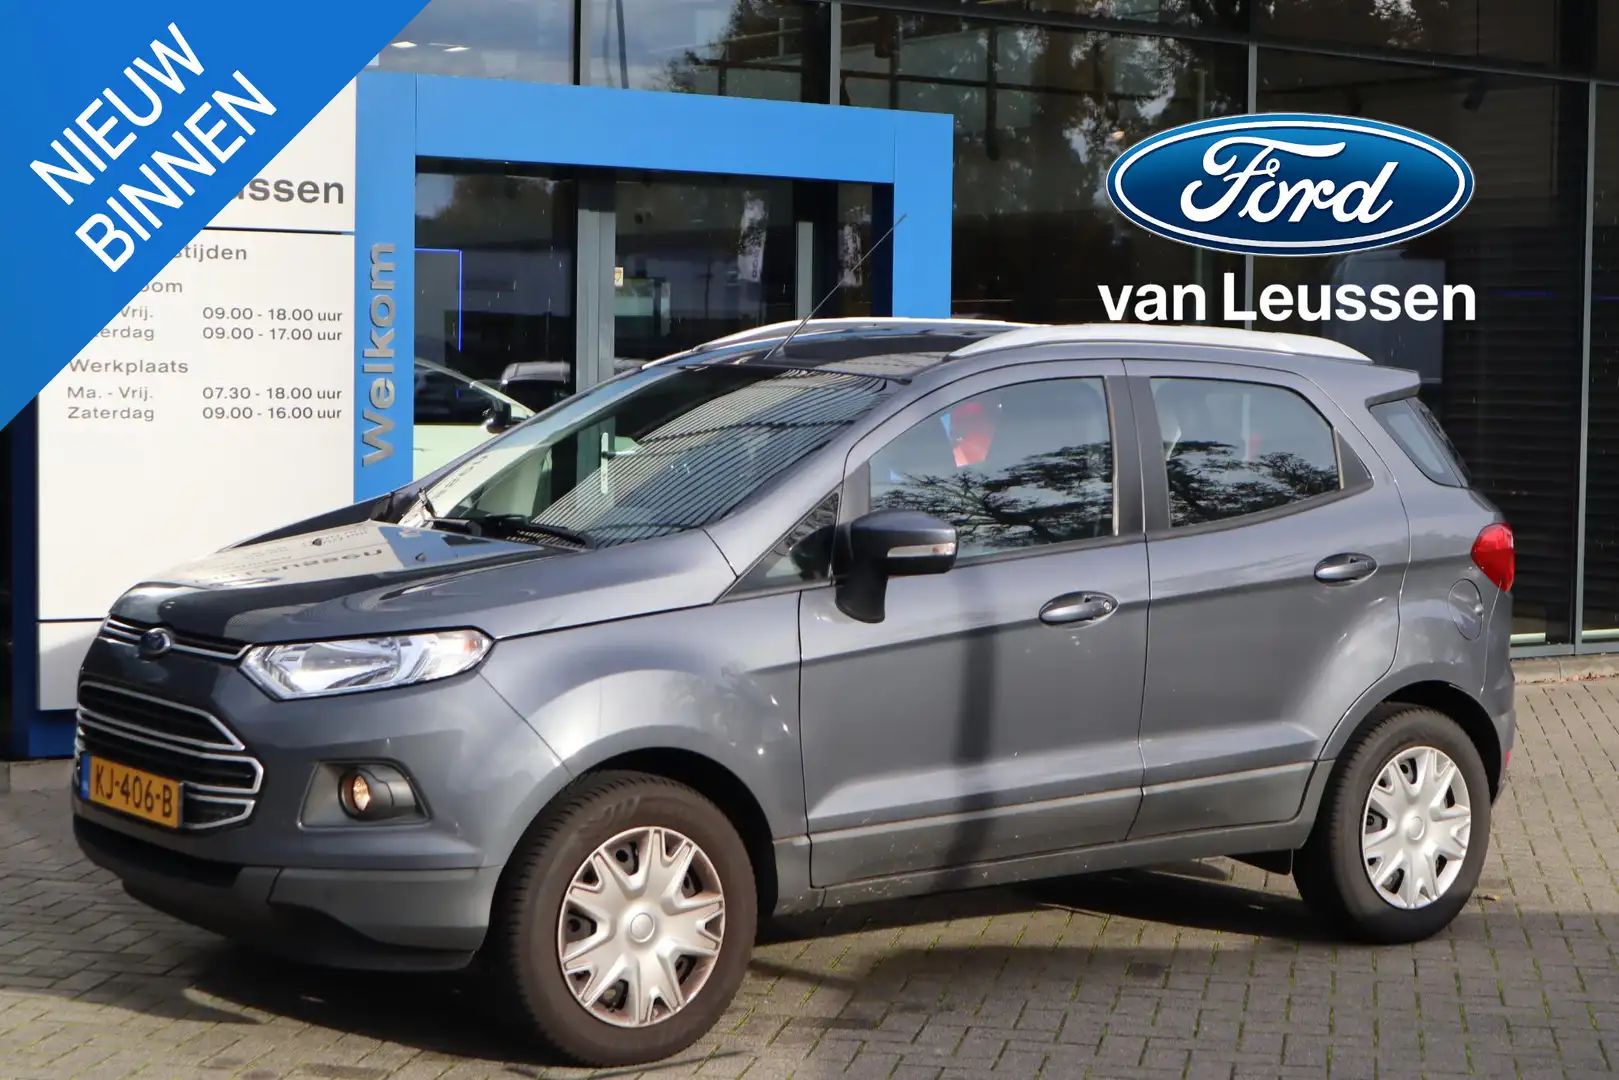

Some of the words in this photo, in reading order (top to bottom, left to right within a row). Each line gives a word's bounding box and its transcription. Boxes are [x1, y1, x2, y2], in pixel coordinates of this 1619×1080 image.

[234, 178, 344, 204] ssen
[202, 307, 253, 320] 09.00
[268, 308, 314, 321] 18.00
[317, 311, 343, 321] uur
[96, 326, 155, 342] erdag
[202, 327, 254, 340] 09.00
[269, 328, 313, 341] 17.00
[317, 331, 343, 341] uur
[361, 242, 396, 468] Welkom
[70, 359, 189, 376] Werkplaats
[67, 386, 102, 399] Ma.
[118, 386, 154, 402] Vrij.
[202, 387, 251, 400] 07.30
[266, 387, 313, 400] 18.00
[317, 390, 342, 400] uur
[67, 406, 155, 422] Zaterdag
[202, 407, 253, 420] 09.00
[268, 407, 314, 420] 16.00
[317, 410, 342, 420] uur
[95, 764, 173, 818] KJ-406-B
